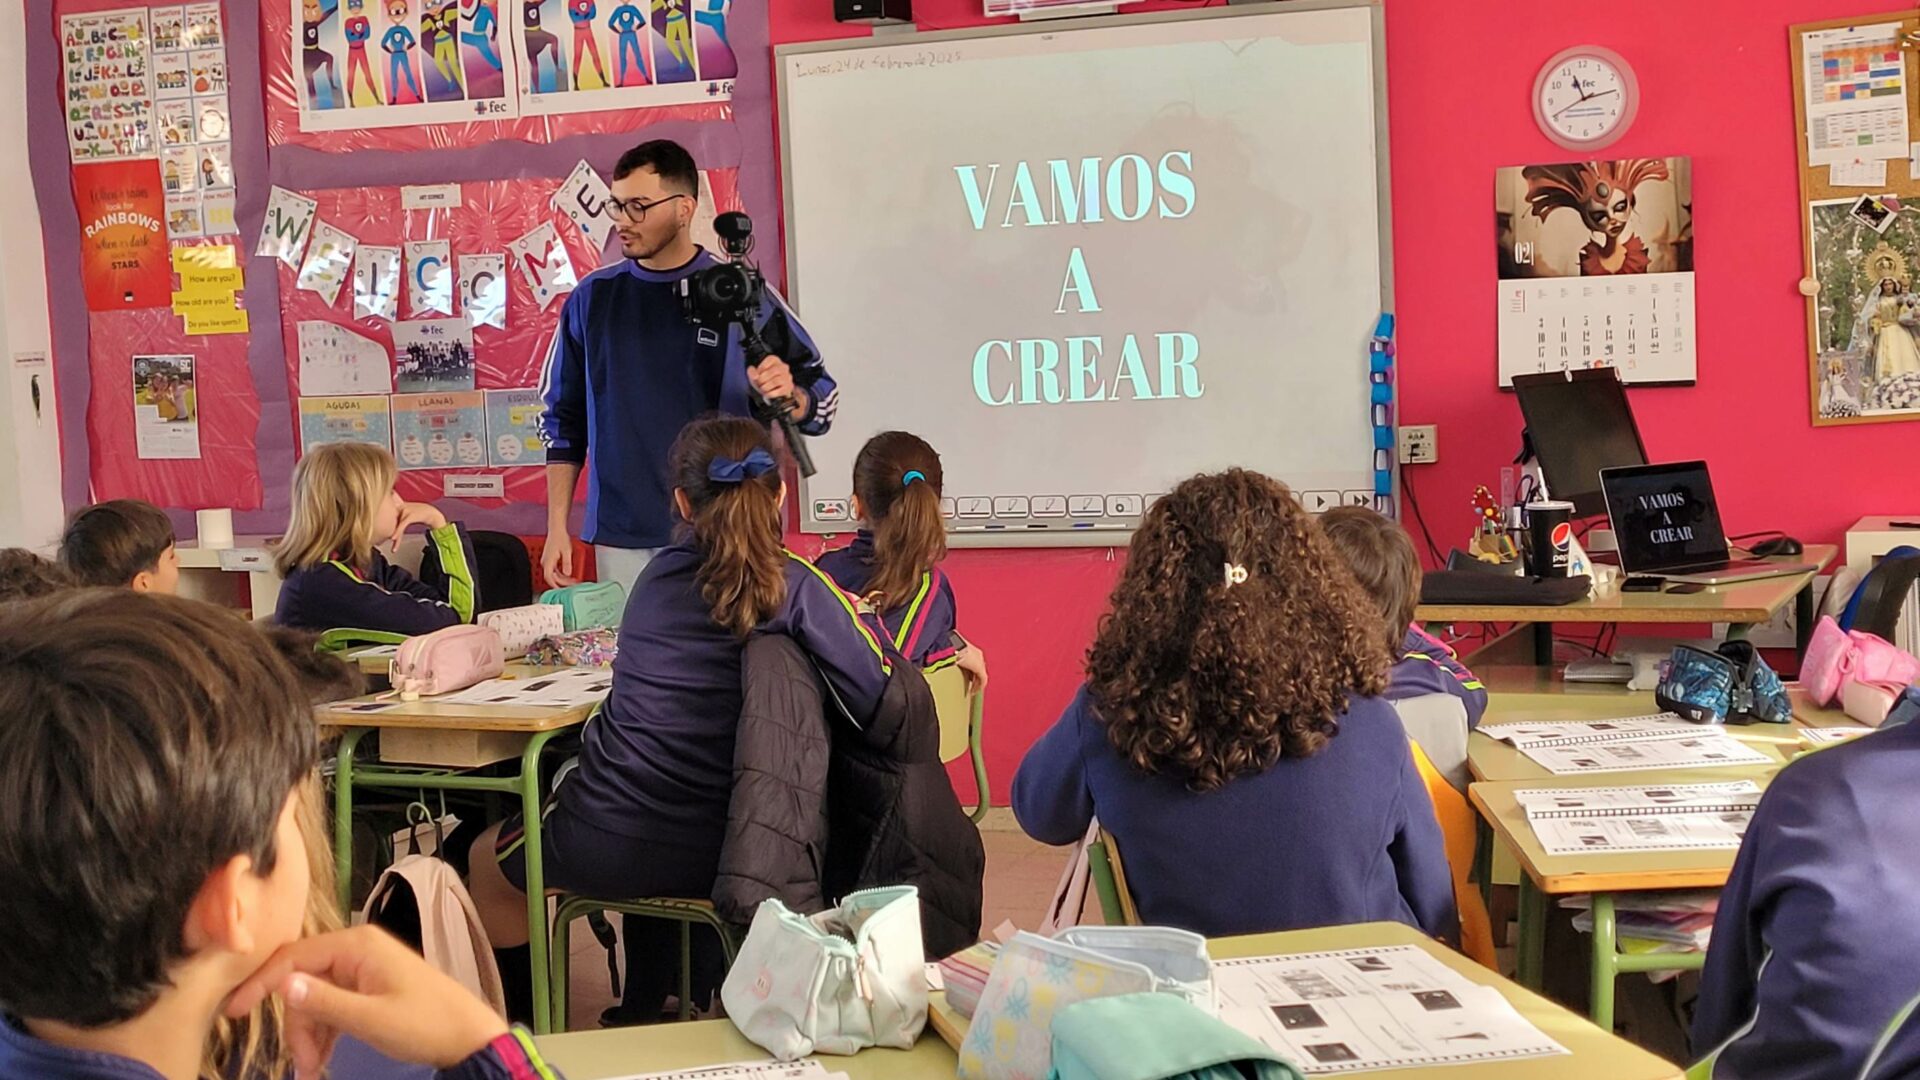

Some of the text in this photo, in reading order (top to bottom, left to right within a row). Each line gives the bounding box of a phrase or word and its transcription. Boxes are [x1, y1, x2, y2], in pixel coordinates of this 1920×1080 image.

[1578, 60, 1588, 69] 12
[1562, 68, 1572, 76] 11
[1610, 73, 1615, 81] 2
[722, 82, 734, 94] fe
[1552, 81, 1561, 90] 10
[1582, 79, 1595, 88] fec
[489, 101, 506, 113] fec
[1568, 125, 1572, 133] 7
[1599, 122, 1604, 130] 5
[1583, 129, 1589, 137] 6
[952, 150, 1196, 230] VAMOS
[84, 212, 160, 238] RAINBOWS
[112, 260, 139, 270] STARS
[1054, 246, 1102, 314] A
[1606, 315, 1611, 326] 6
[431, 325, 444, 334] fec
[971, 331, 1205, 407] CREAR
[326, 401, 360, 410] AGUDAS
[418, 397, 454, 406] LLANAS
[1638, 492, 1685, 510] VAMOS
[1663, 511, 1672, 525] A
[1650, 526, 1694, 544] CREAR
